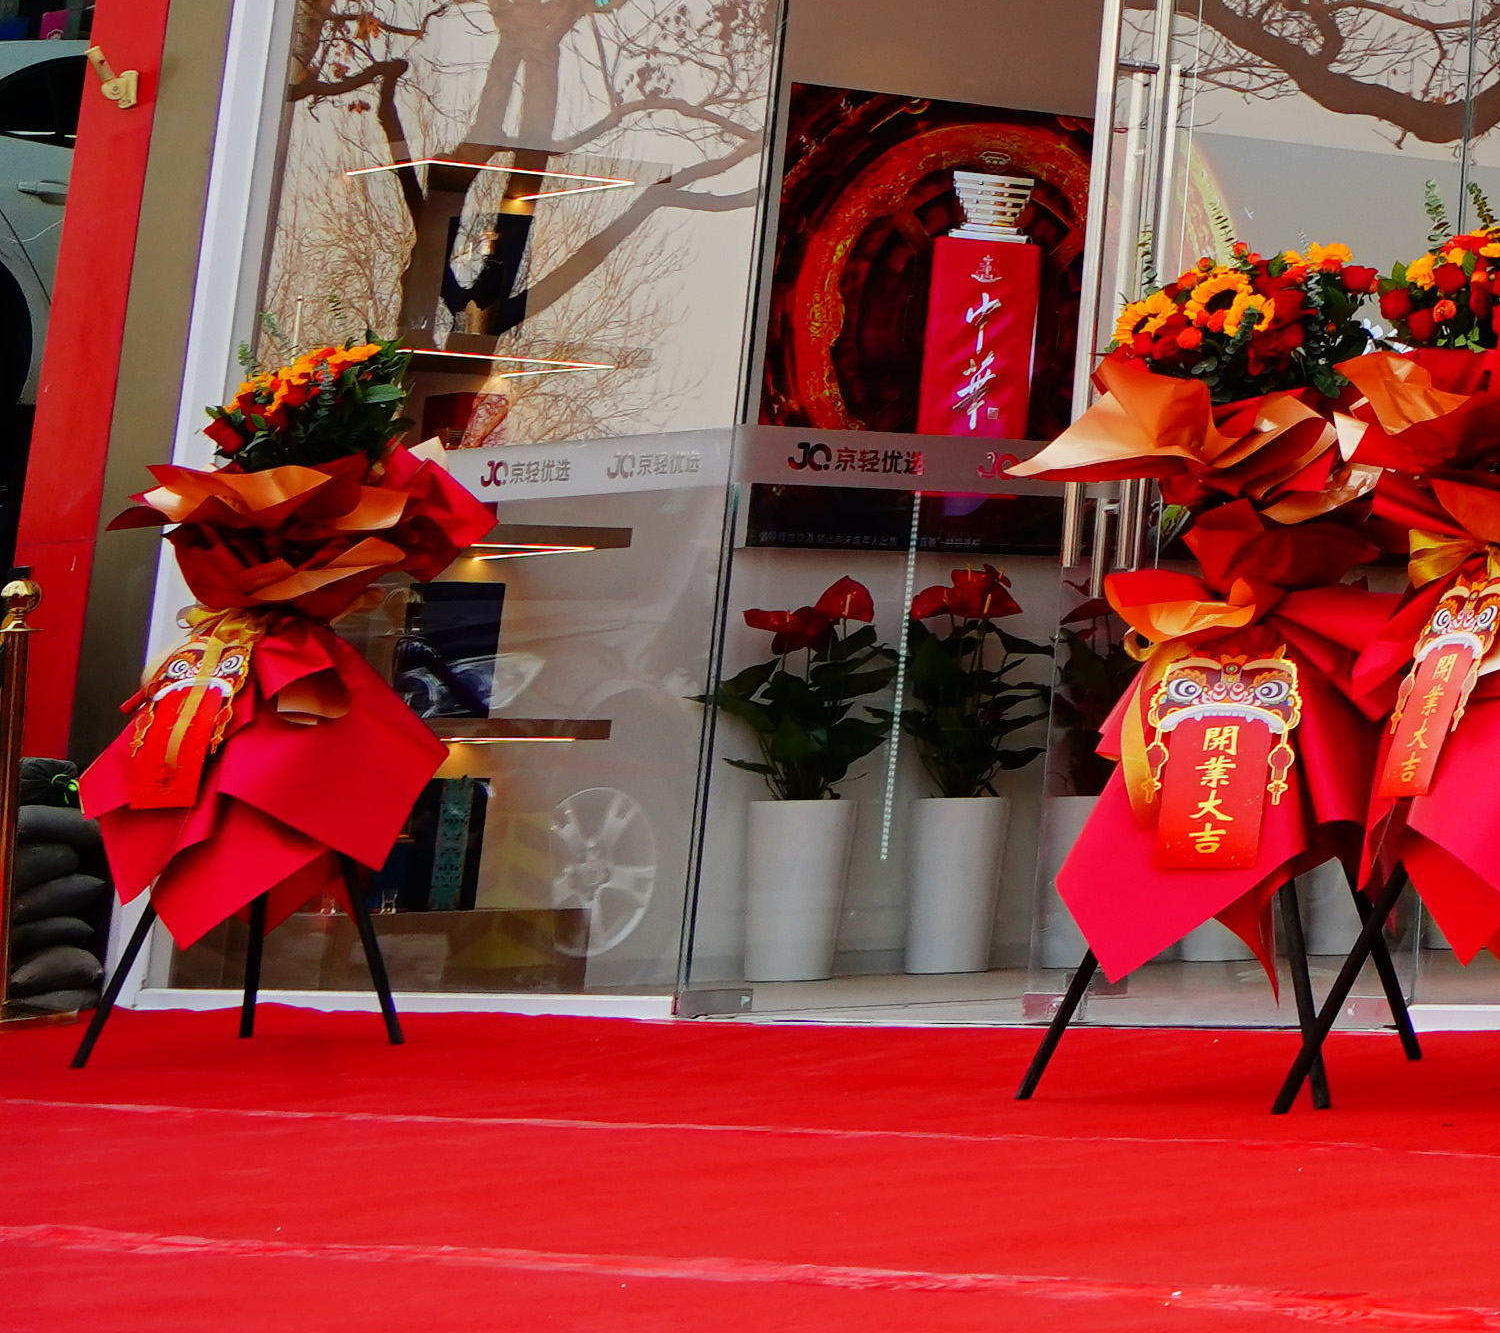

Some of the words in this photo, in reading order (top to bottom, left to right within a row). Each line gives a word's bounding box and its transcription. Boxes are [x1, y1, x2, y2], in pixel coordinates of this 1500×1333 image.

[509, 458, 571, 485] 京轻优选
[638, 450, 702, 477] 京轻优选
[835, 446, 925, 476] 京轻优选
[1400, 652, 1459, 783] 開業大吉
[1188, 724, 1241, 854] 開業大吉
